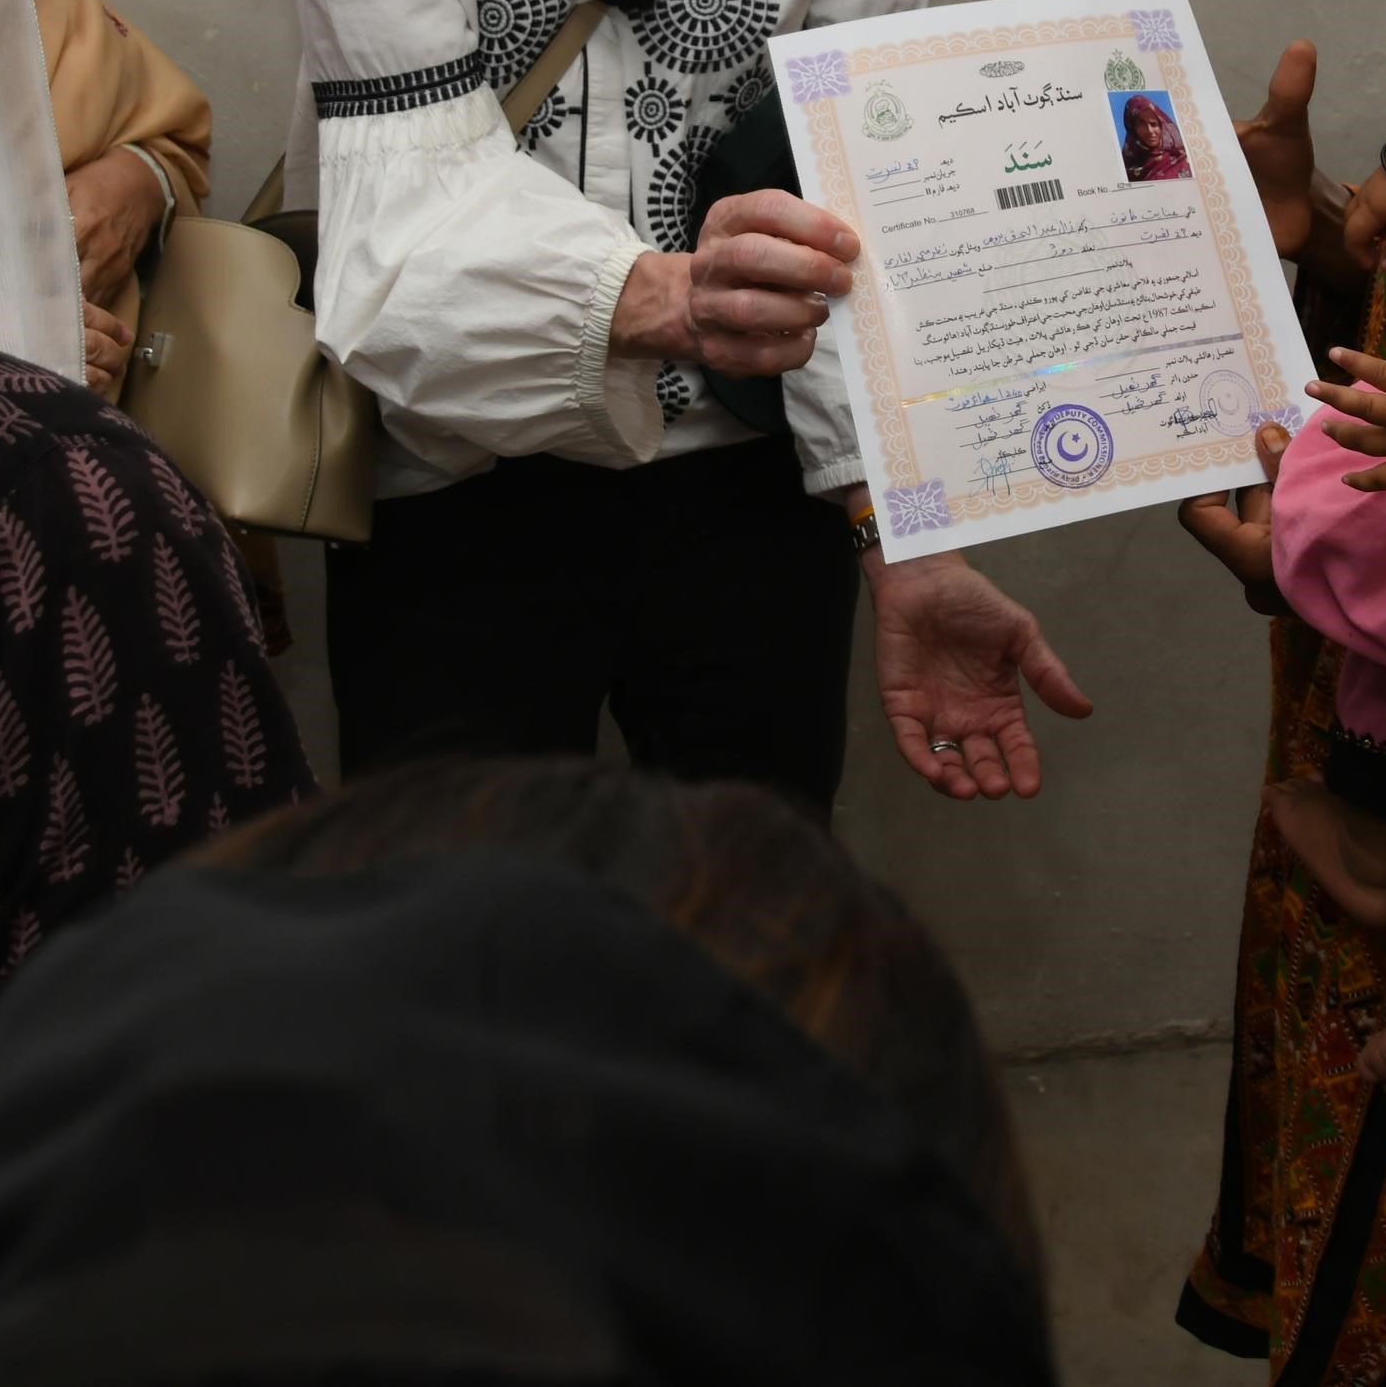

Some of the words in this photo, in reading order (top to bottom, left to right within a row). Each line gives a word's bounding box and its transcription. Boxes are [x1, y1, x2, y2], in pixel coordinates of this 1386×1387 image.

[997, 86, 1020, 113] آباد
[1077, 188, 1096, 197] Book
[881, 220, 922, 234] Certificate
[1054, 409, 1088, 421] DEPUTY
[1087, 416, 1109, 477] COMMISSIONER
